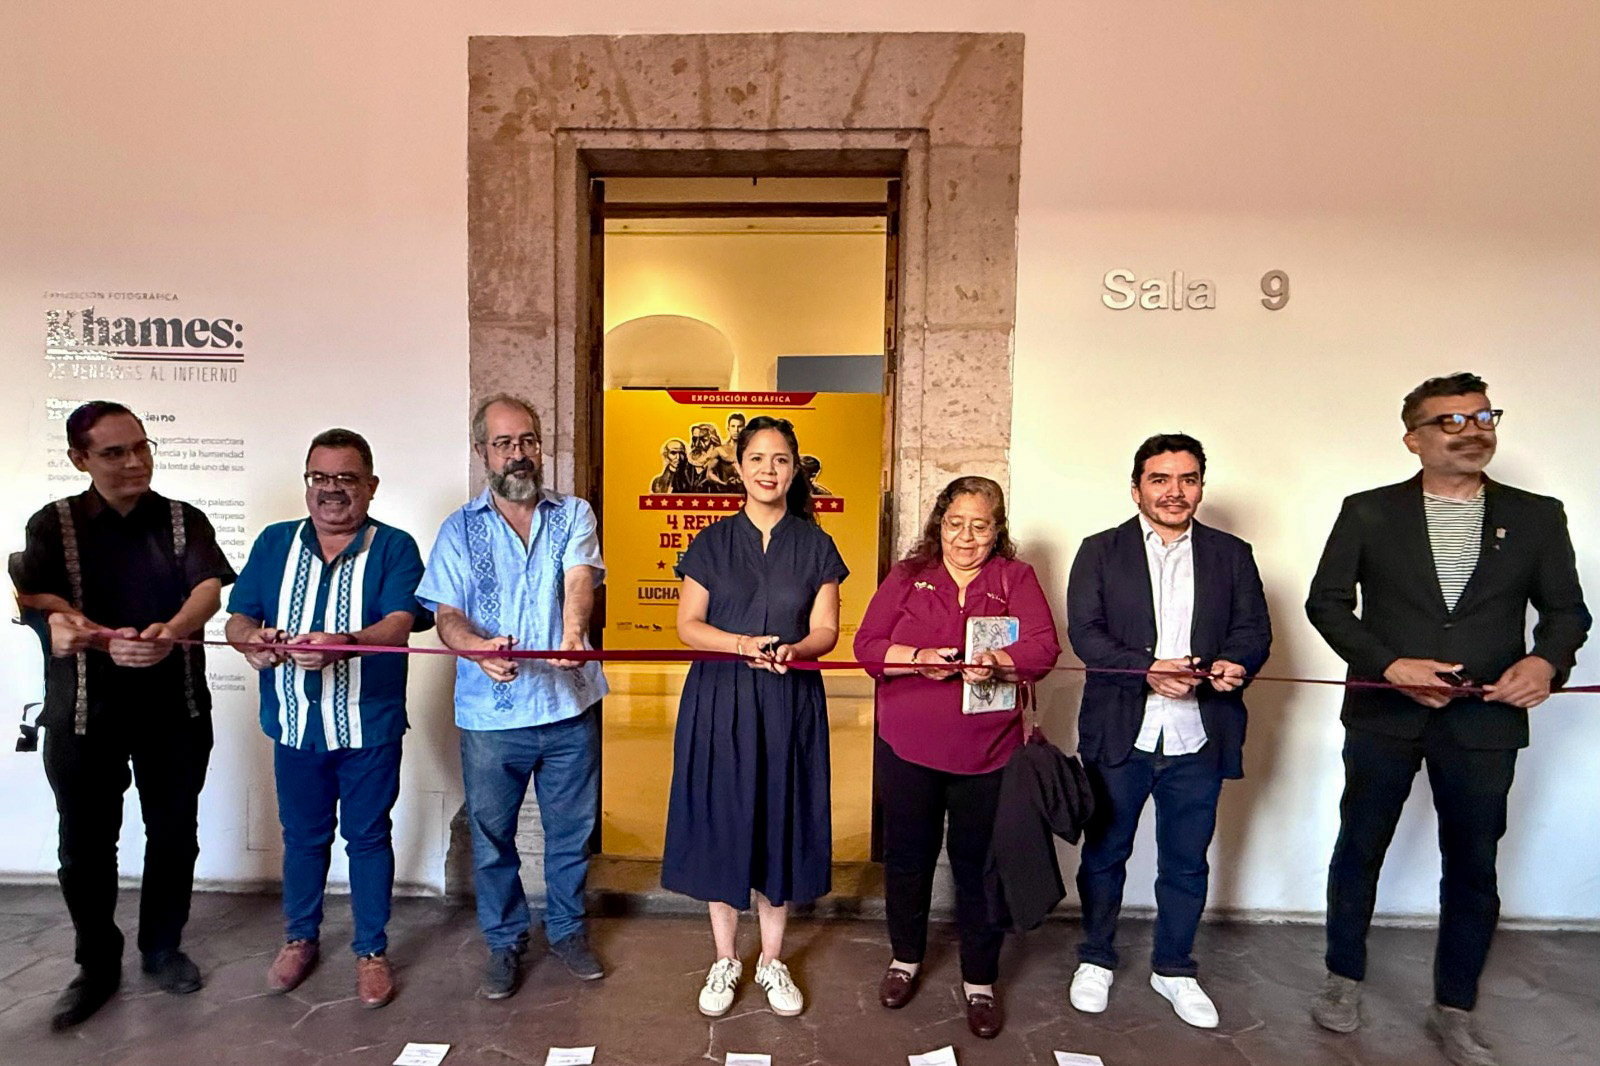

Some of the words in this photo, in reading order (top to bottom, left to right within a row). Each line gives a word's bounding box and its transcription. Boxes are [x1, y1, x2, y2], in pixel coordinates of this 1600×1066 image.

[1101, 268, 1217, 311] Sala
[1260, 269, 1291, 311] 9
[150, 365, 166, 381] AL
[173, 366, 238, 384] INFIERNO
[691, 393, 748, 403] EXPOSICIÓN
[750, 394, 791, 403] GRÁFICA
[666, 514, 678, 530] 4
[659, 532, 682, 549] DE
[638, 587, 680, 600] LUCHA
